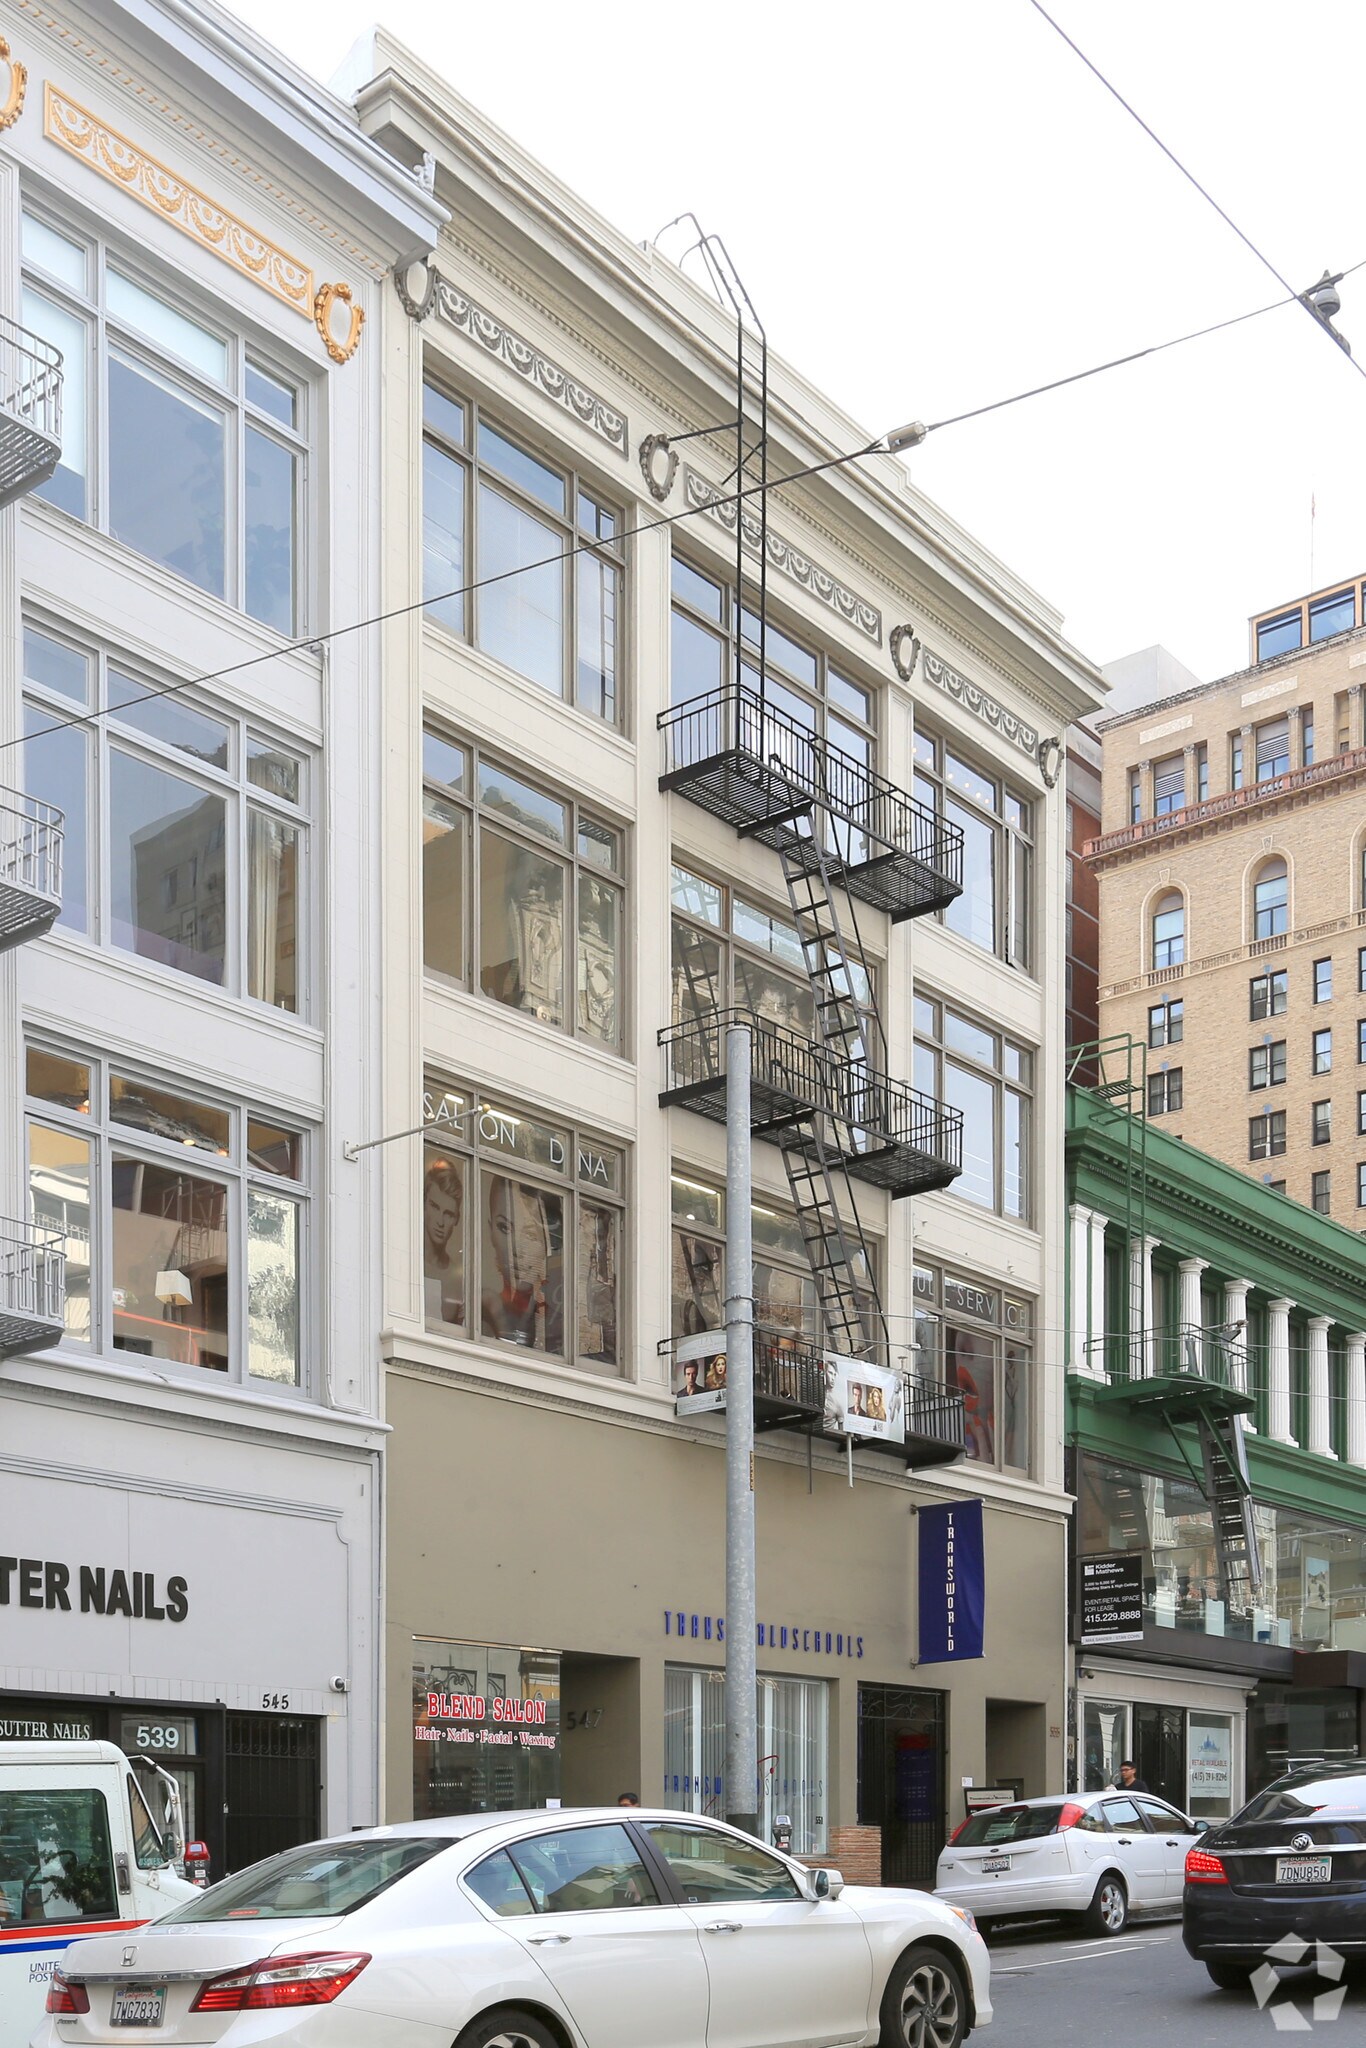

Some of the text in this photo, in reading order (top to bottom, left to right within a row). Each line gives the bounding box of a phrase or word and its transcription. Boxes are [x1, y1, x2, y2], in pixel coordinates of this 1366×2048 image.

[423, 1092, 608, 1182] SALON DNA
[957, 1286, 1027, 1325] SERVCE
[945, 1512, 956, 1652] TRANSWORLD
[80, 1565, 189, 1623] NAILS
[1121, 1594, 1140, 1602] SPACE
[1084, 1610, 1141, 1623] 415.229.8888
[262, 1693, 289, 1710] 545
[427, 1692, 547, 1724] BLEND SALON
[0, 1720, 90, 1740] SUTTER NAILS
[566, 1708, 604, 1731] 547
[136, 1725, 180, 1749] 539
[414, 1725, 557, 1749] Hair Nails Facial Waxing
[1281, 1865, 1327, 1880] 7DNU850
[29, 1960, 61, 1973] UNITE
[116, 2001, 161, 2019] 7WGZ833
